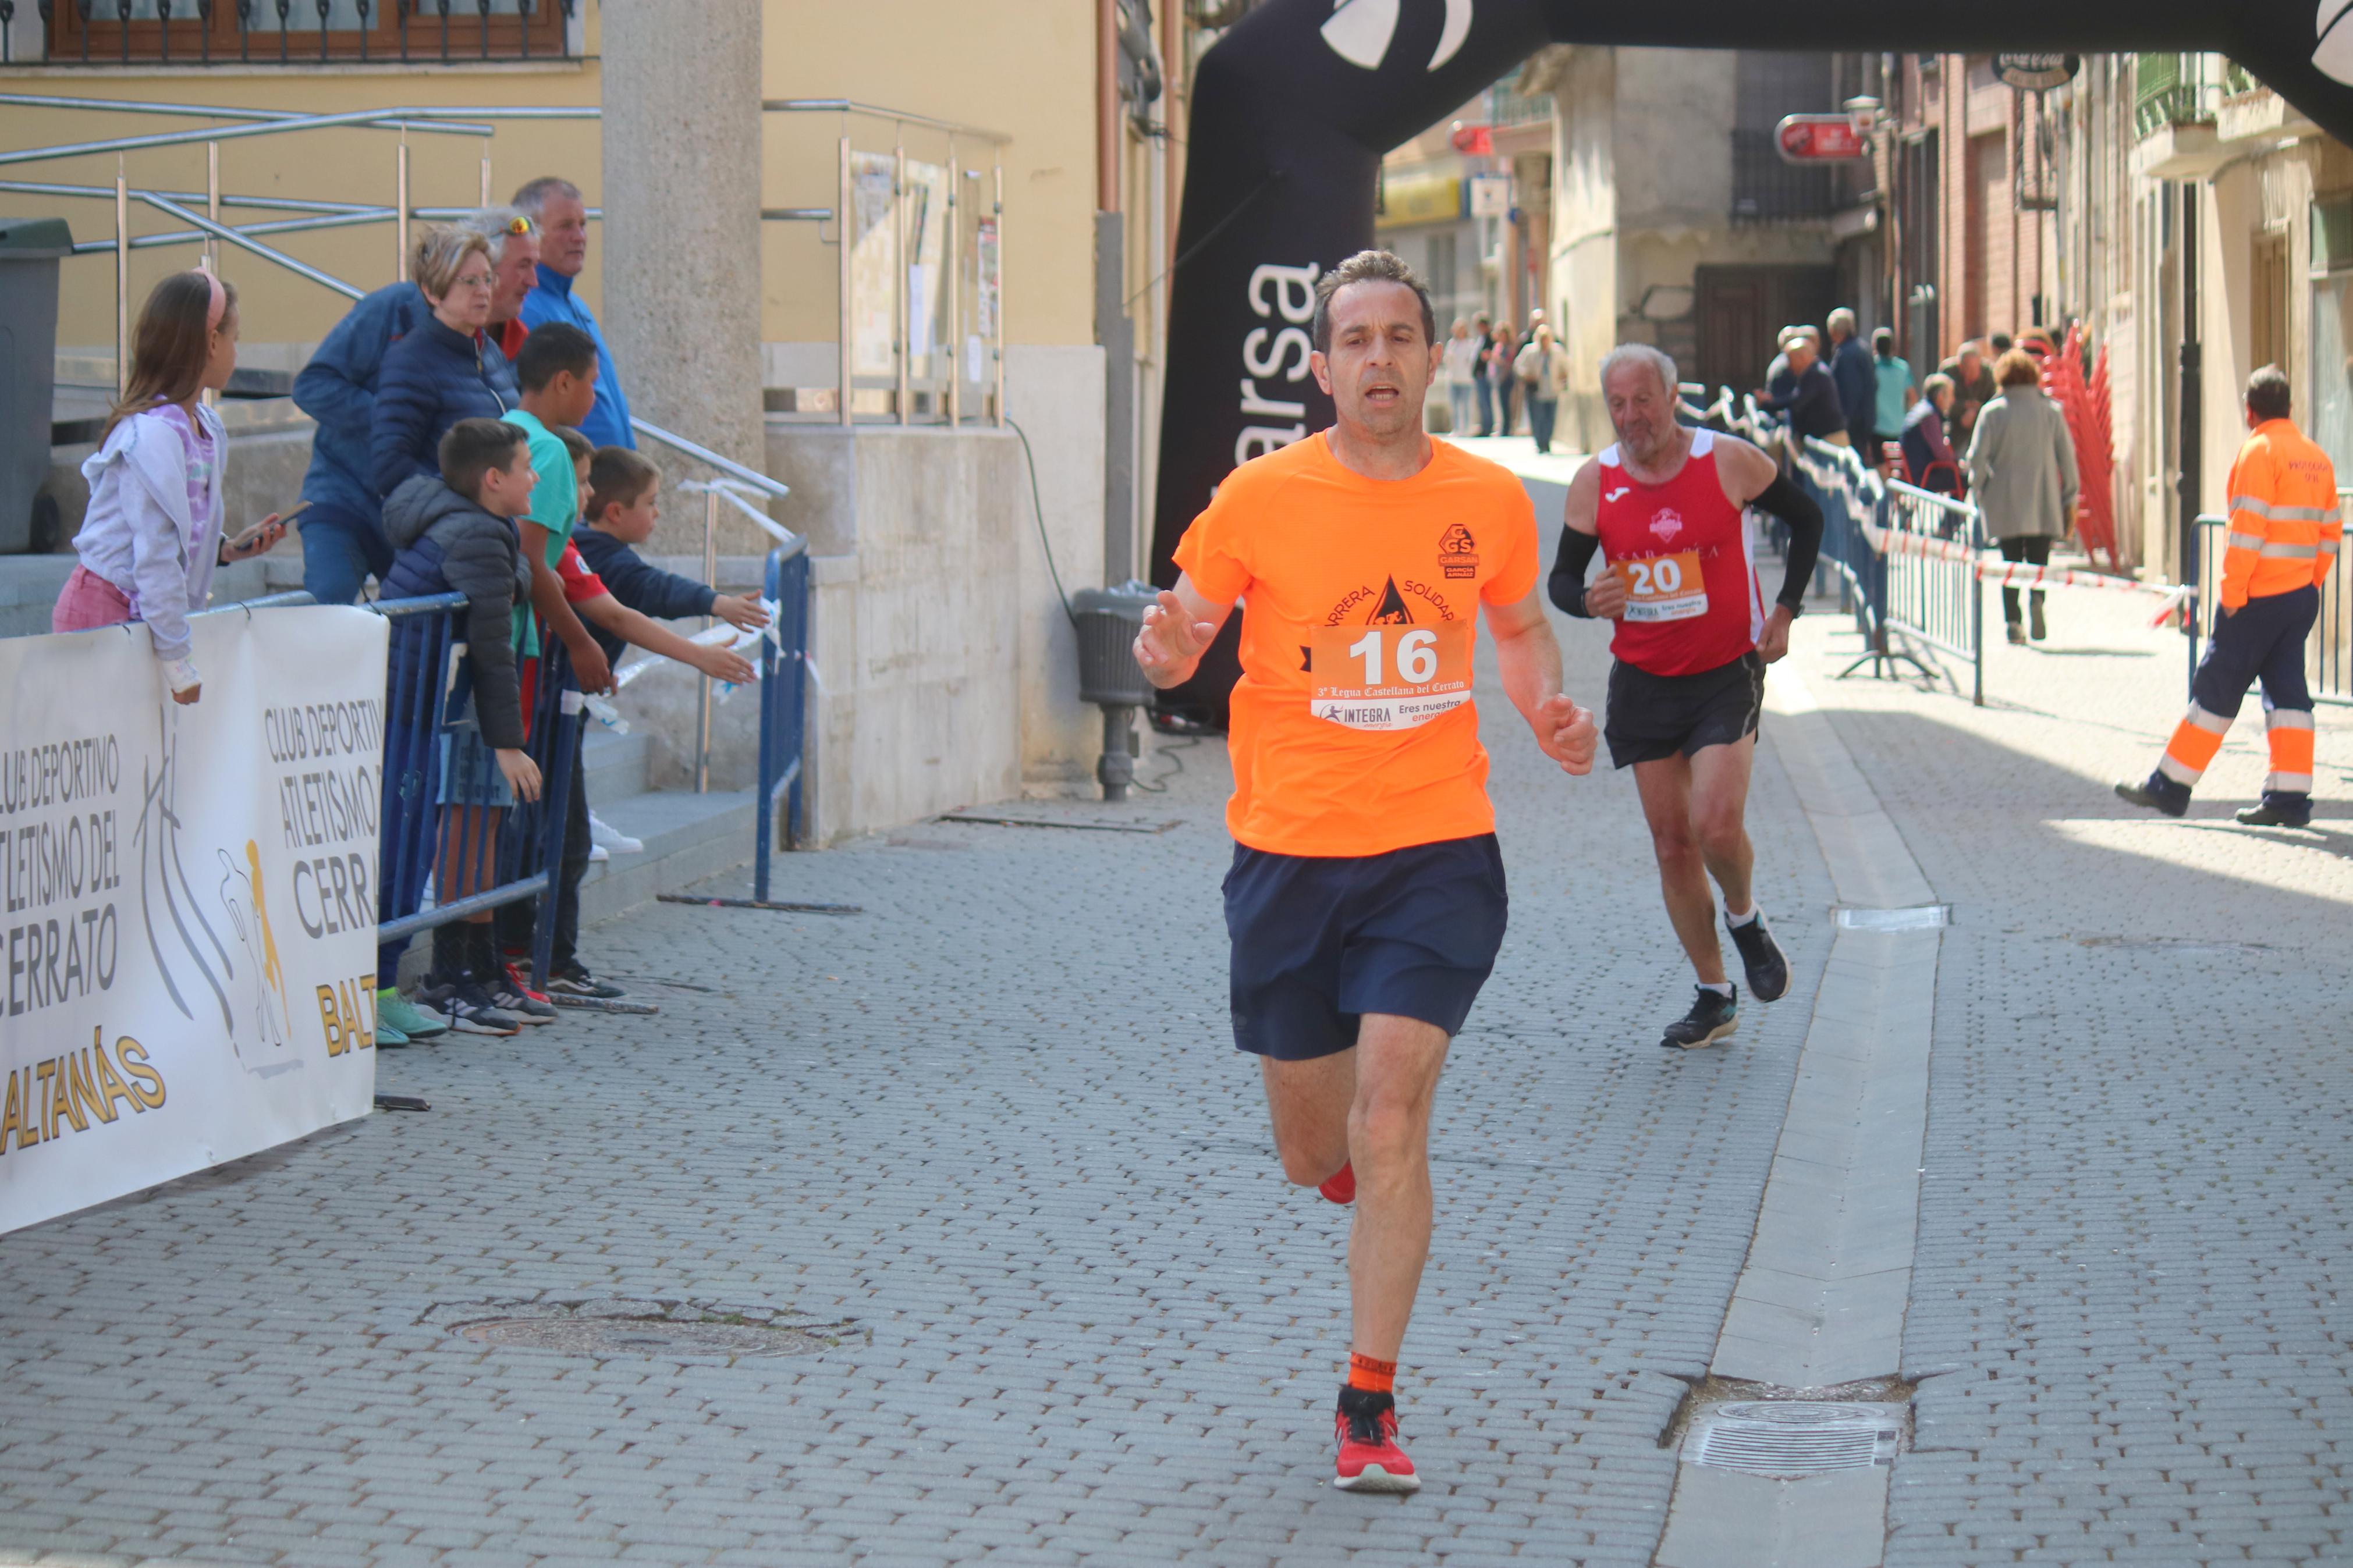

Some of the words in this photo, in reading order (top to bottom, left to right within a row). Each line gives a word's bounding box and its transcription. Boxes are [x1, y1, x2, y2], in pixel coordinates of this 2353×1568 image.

[1403, 580, 1454, 621] SOLIDAR
[1628, 559, 1681, 595] 20
[1350, 629, 1438, 685] 16
[1318, 687, 1328, 696] 3º
[1330, 687, 1361, 698] Legua
[1364, 685, 1414, 696] Castellana
[1417, 684, 1429, 694] del
[1432, 681, 1464, 692] Cerrato
[1344, 707, 1391, 722] INTEGRA
[1399, 705, 1421, 714] Eres
[1422, 699, 1461, 712] nuestra
[265, 708, 307, 763] CLUB
[0, 748, 27, 815] UB
[32, 733, 119, 808] DEPORTIVO
[279, 765, 376, 849] ATLETISMO
[90, 809, 119, 893] DEL
[0, 903, 116, 1018] ERRATO
[316, 973, 375, 1058] BALT
[0, 1025, 166, 1155] ALTANÁS
